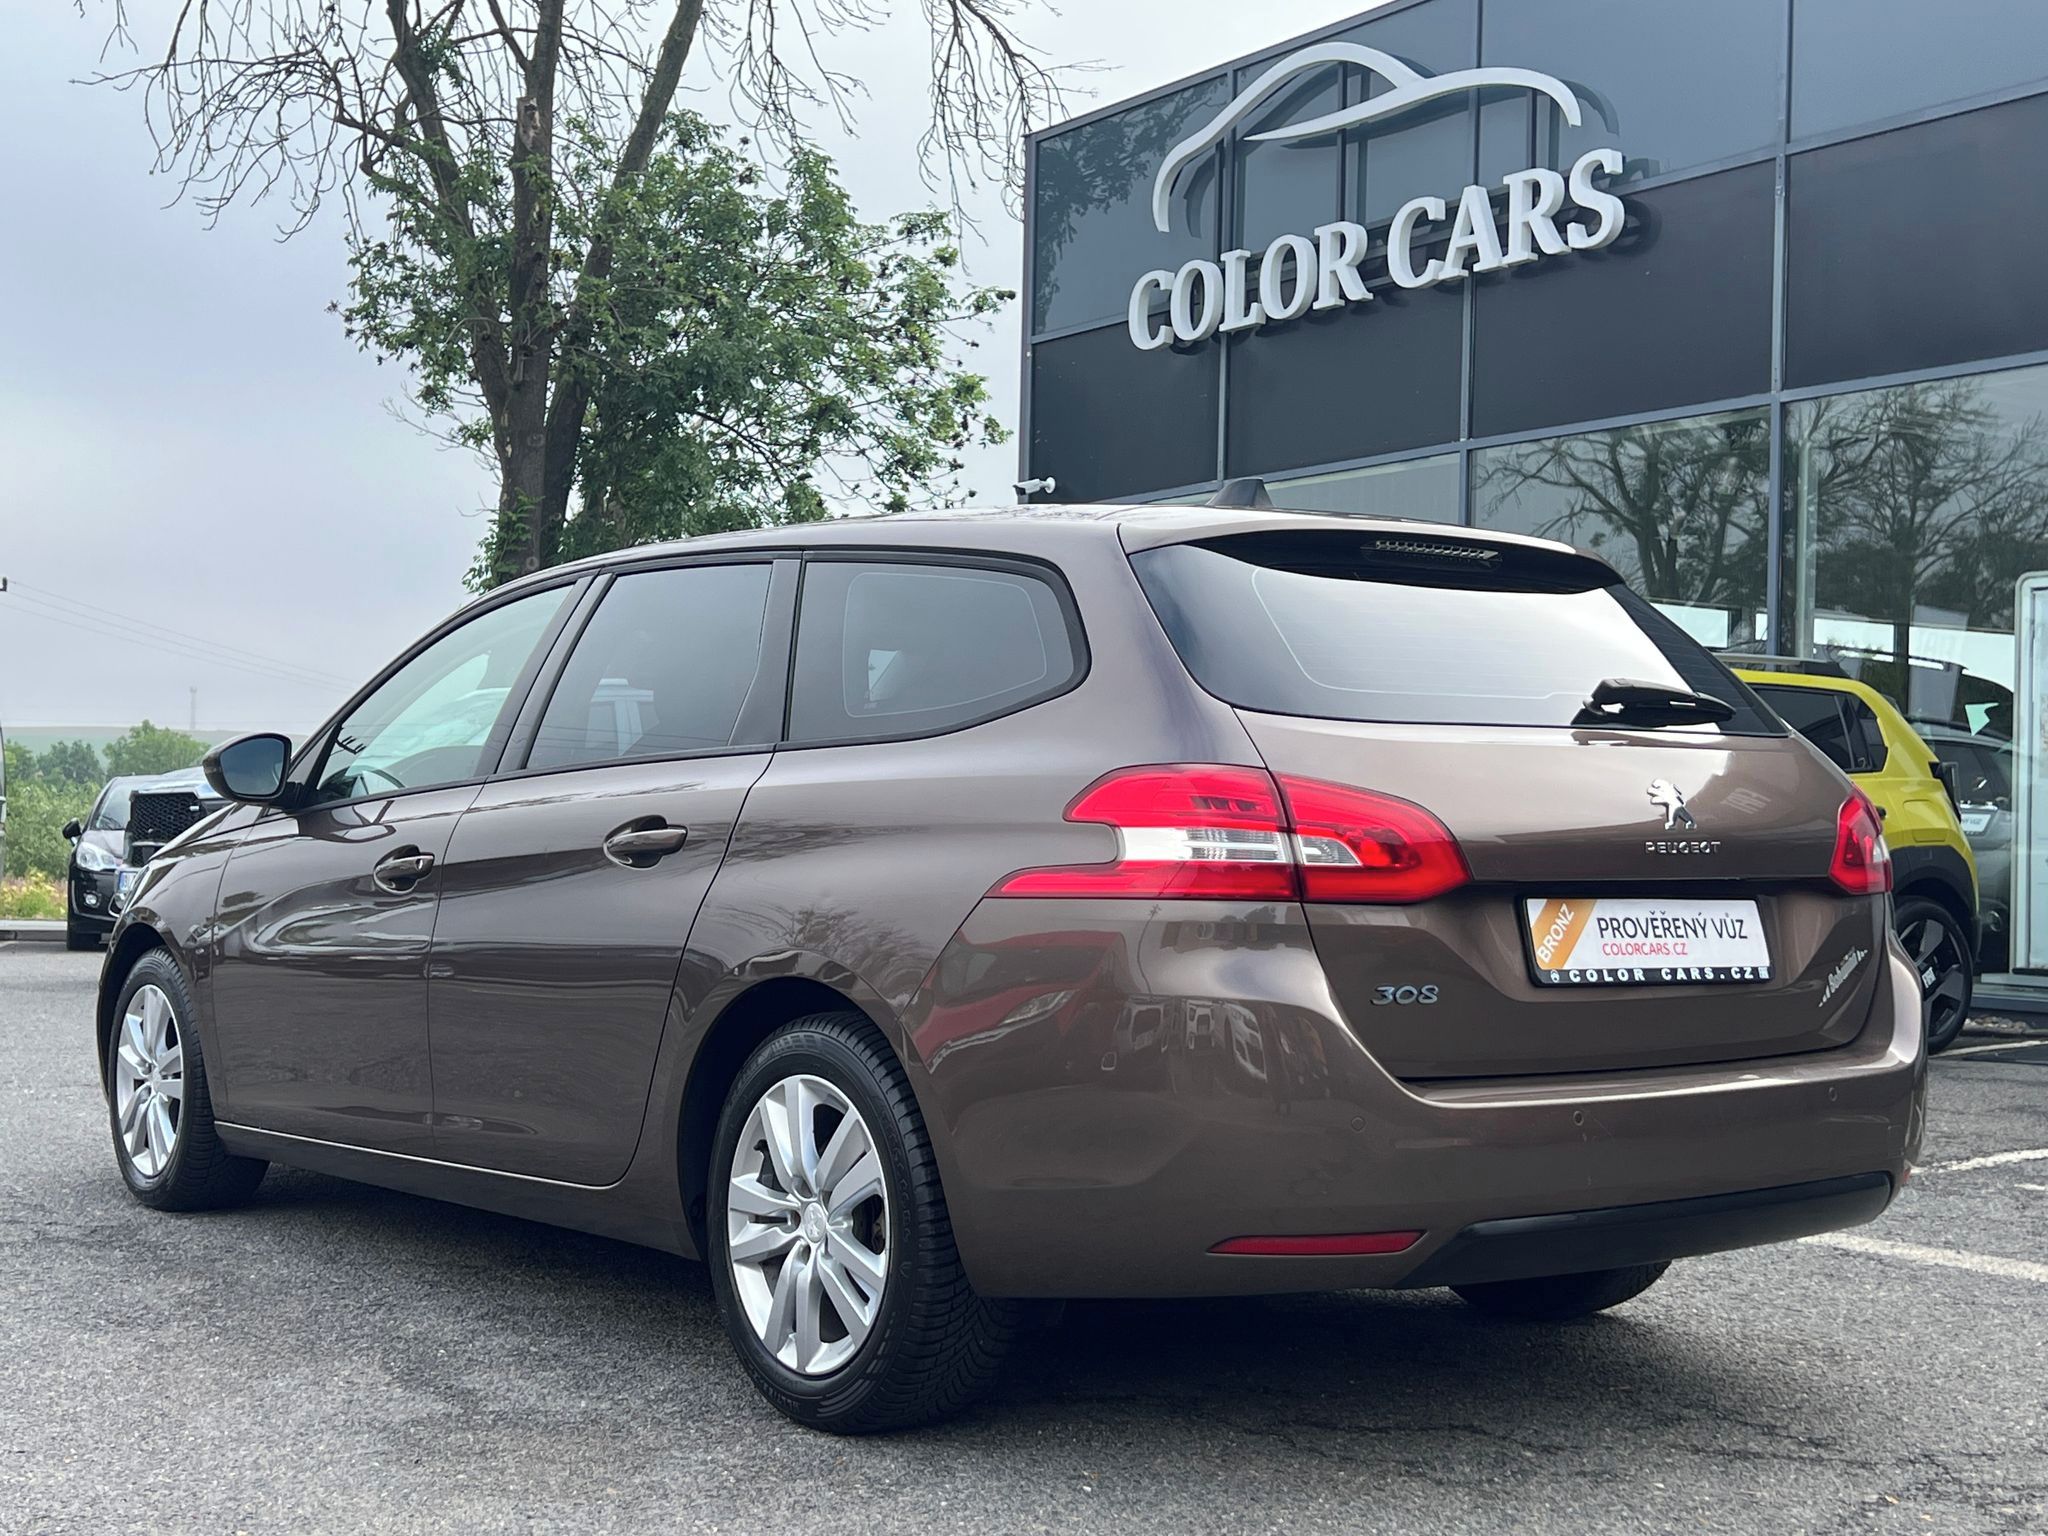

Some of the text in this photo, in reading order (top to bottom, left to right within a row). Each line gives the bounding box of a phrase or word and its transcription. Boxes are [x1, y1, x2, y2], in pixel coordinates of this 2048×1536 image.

[1128, 148, 1625, 351] COLOR CARS
[1644, 841, 1721, 854] PEUGEOT
[1536, 903, 1575, 964] BRONZ
[1596, 910, 1749, 940] PROVĚŘENÝ VŮZ
[1602, 942, 1688, 956] COLORCARS.CZ
[1568, 968, 1646, 983] COLOR
[1370, 984, 1439, 1005] 308
